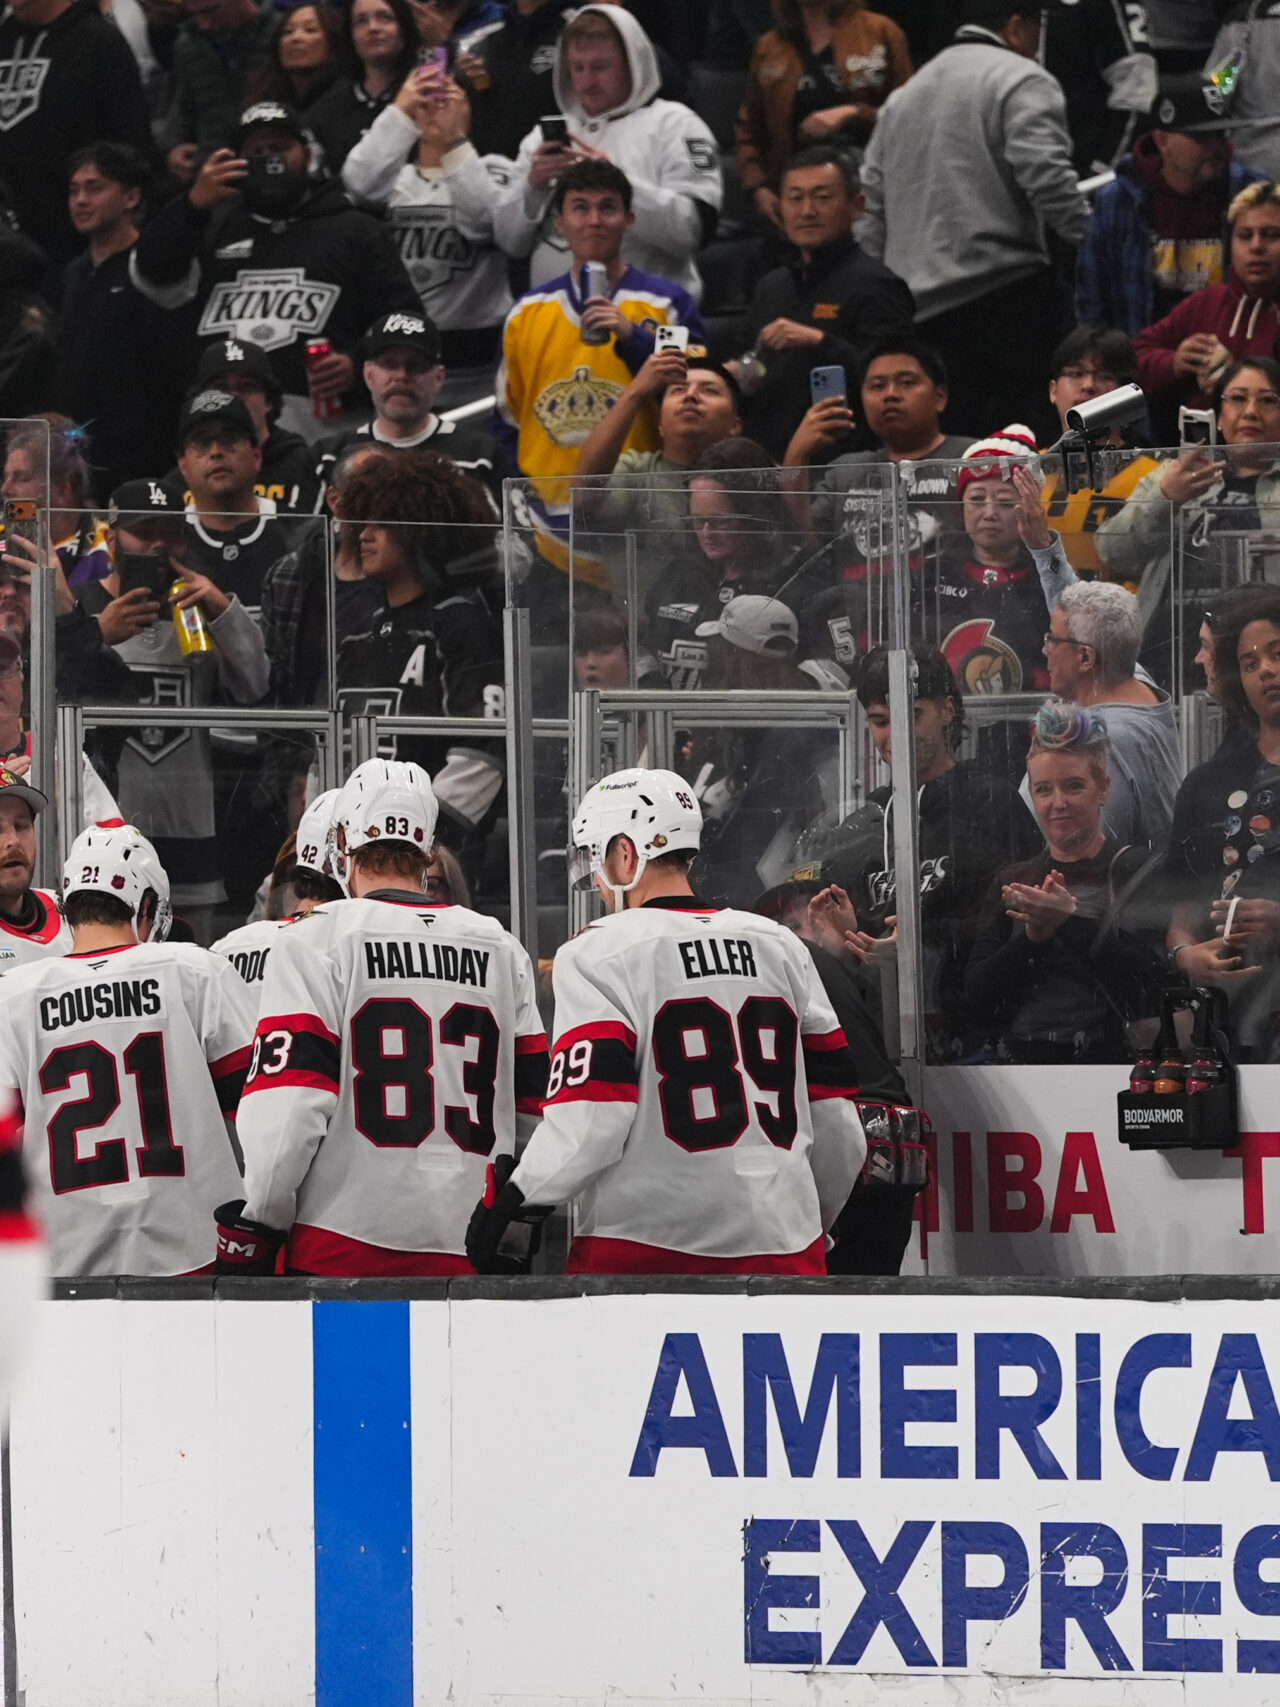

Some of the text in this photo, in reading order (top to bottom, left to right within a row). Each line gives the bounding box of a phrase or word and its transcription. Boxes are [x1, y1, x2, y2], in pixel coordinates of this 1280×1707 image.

[214, 289, 324, 323] KINGS
[225, 340, 244, 361] LA
[148, 482, 167, 505] LA
[828, 616, 857, 664] 5
[399, 645, 426, 687] A
[605, 781, 637, 791] Fullscript
[675, 792, 693, 810] 89
[385, 815, 409, 837] 83
[301, 844, 318, 864] 42
[81, 866, 99, 883] 21
[364, 941, 489, 988] HALLIDAY
[678, 938, 757, 979] ELLER
[40, 979, 161, 1031] COUSINS
[350, 997, 500, 1157] 83
[545, 1039, 593, 1099] 89
[652, 995, 798, 1153] 89
[38, 1031, 185, 1196] 21
[1124, 1109, 1184, 1124] BODYARMOR
